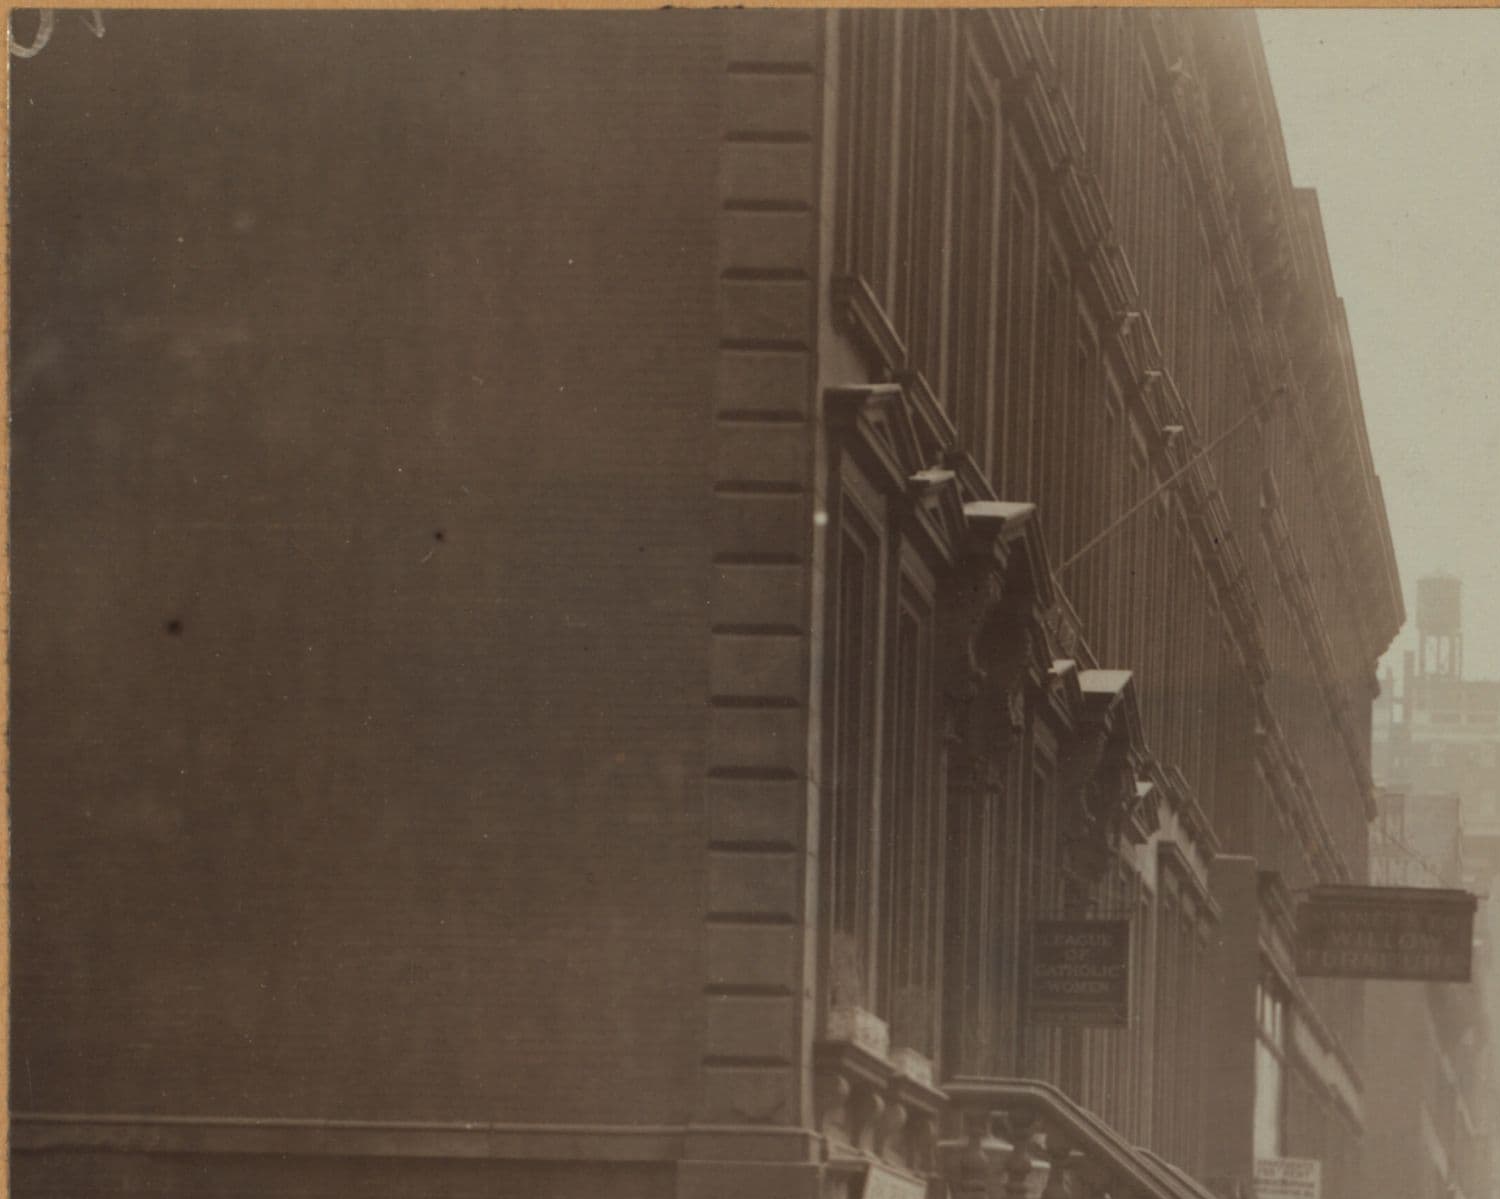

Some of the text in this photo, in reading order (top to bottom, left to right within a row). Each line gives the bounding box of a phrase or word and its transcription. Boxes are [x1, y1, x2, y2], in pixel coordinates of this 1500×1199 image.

[1042, 934, 1113, 947] LEAGUE
[1330, 931, 1443, 951] WILLOW
[1065, 948, 1090, 961] OF
[1034, 963, 1121, 978] CATHOLIC
[1047, 981, 1110, 994] WOMEN
